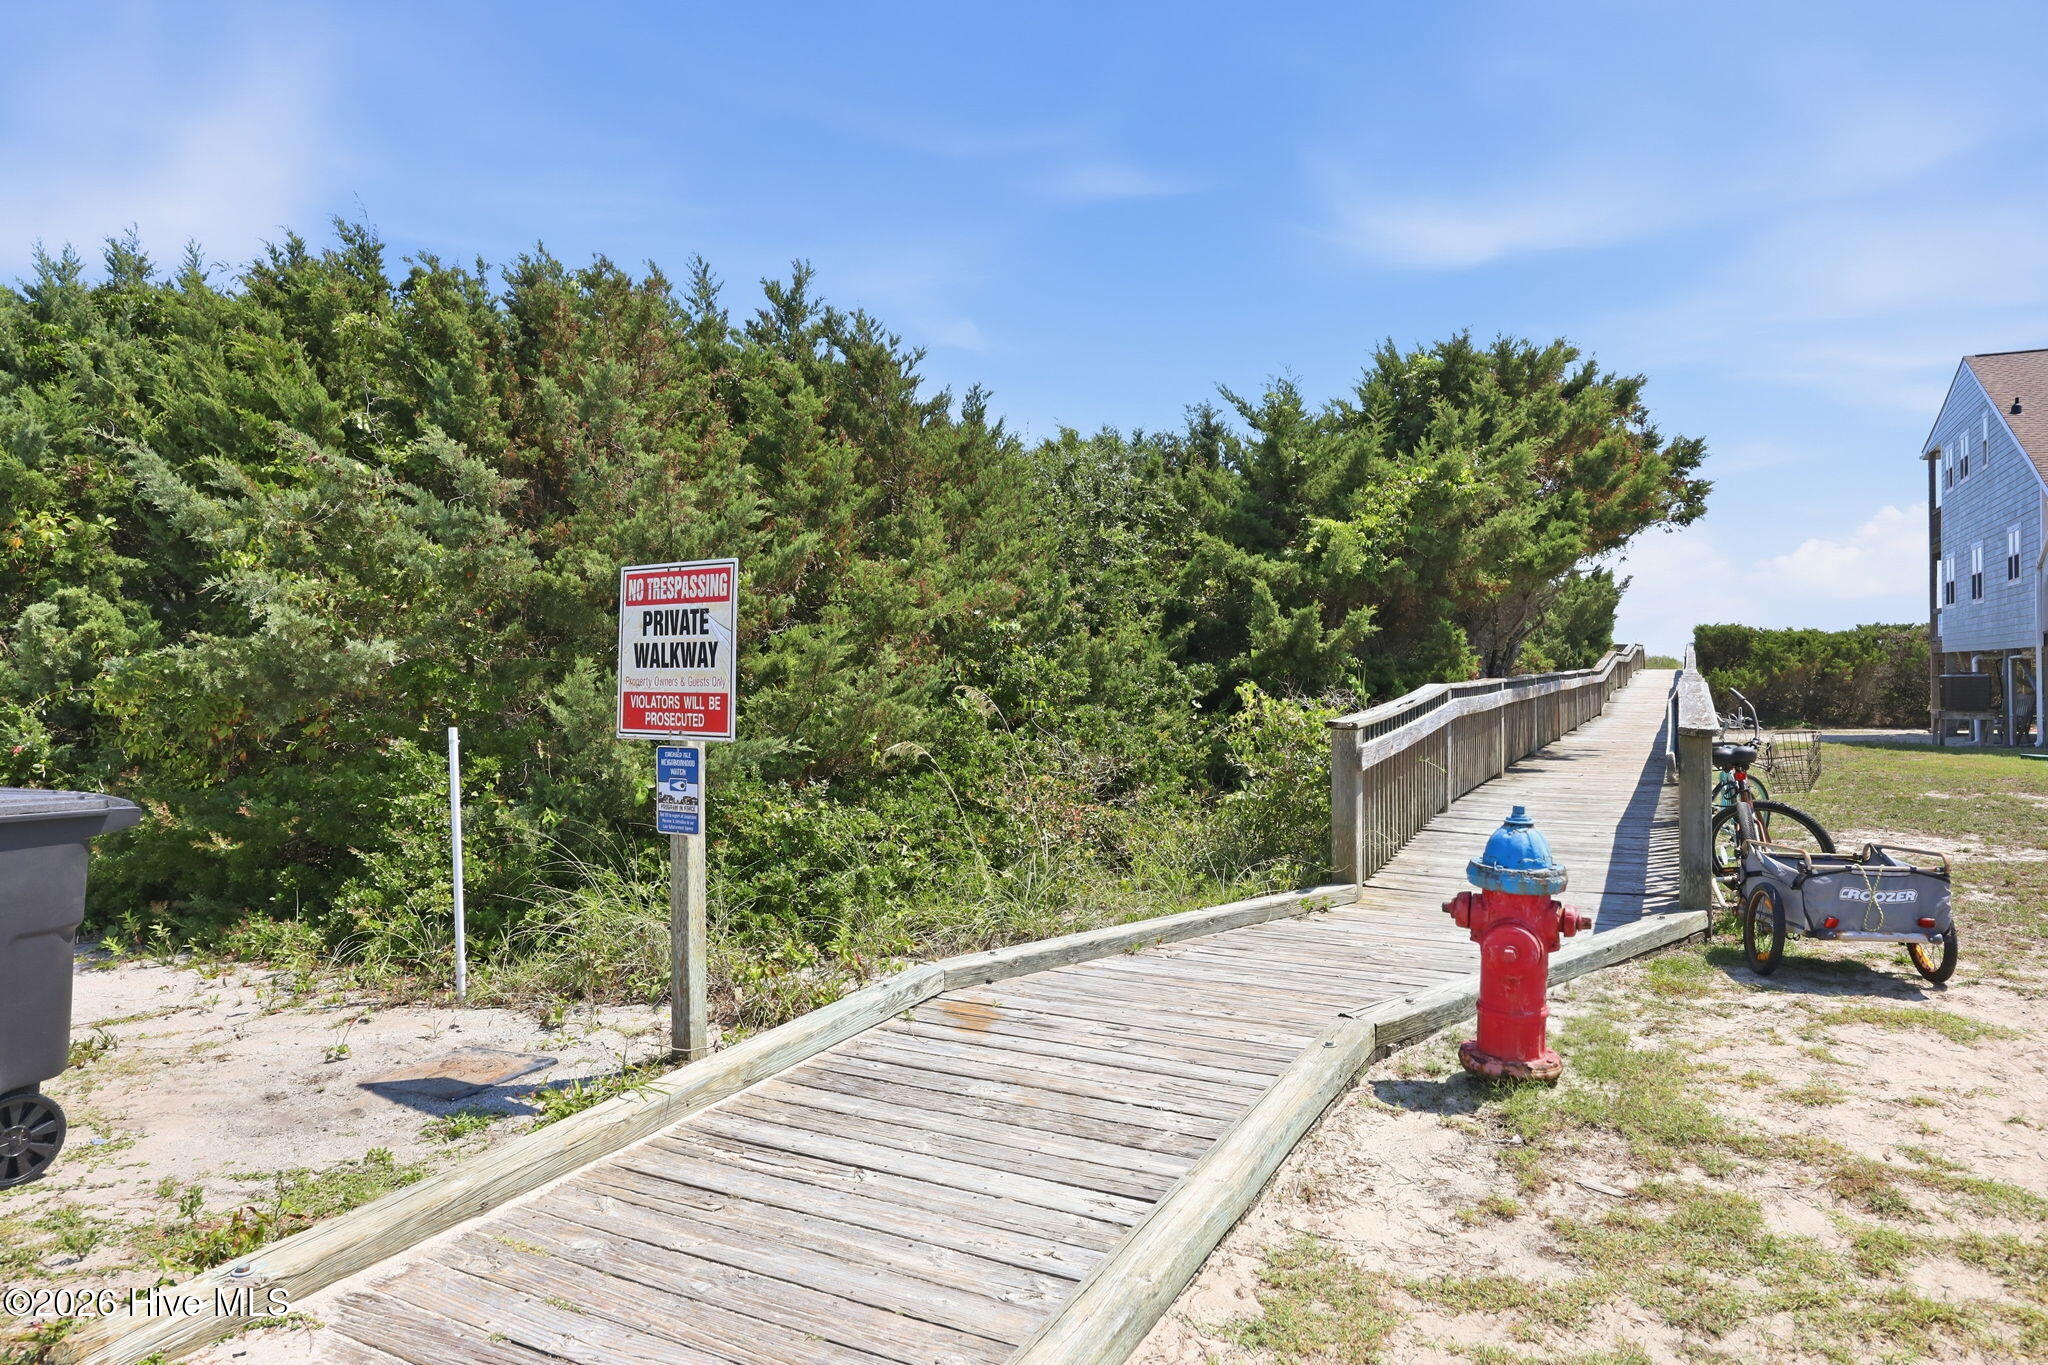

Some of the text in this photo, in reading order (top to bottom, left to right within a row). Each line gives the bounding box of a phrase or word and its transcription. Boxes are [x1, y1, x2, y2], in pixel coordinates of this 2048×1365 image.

[628, 573, 728, 601] NO TRESPASSING
[642, 608, 710, 636] PRIVATE
[634, 641, 719, 668] WALKWAY
[625, 676, 727, 689] Property Owners & Guests Only
[630, 694, 721, 710] VIOLATORS WILL BE
[645, 711, 705, 727] PROSECUTED
[1840, 888, 1917, 902] CROOZER
